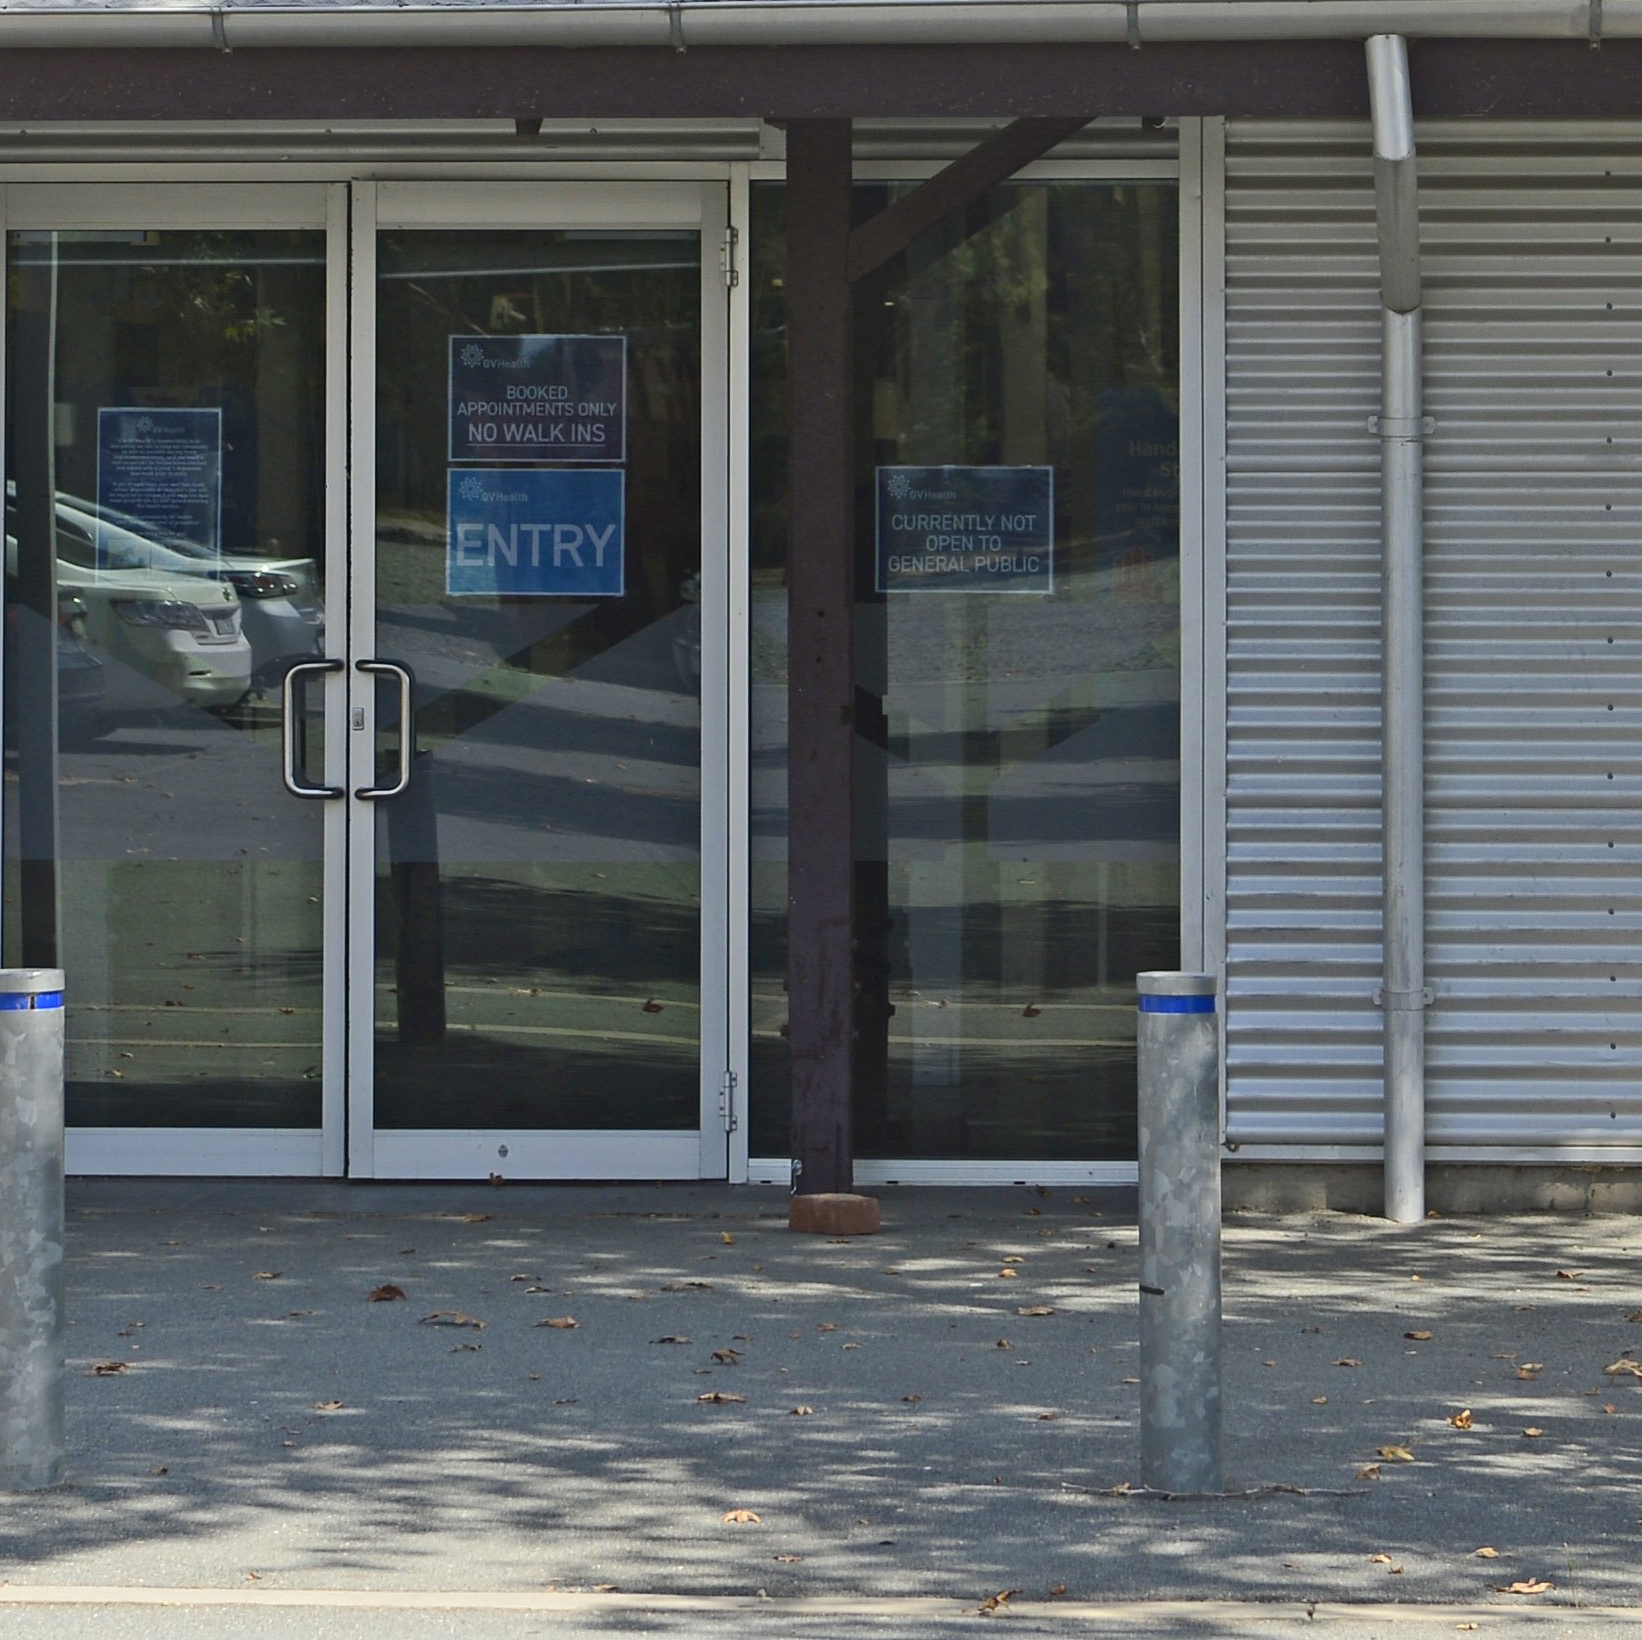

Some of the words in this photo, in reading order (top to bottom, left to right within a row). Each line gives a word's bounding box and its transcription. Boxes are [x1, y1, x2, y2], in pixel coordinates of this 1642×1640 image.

[507, 385, 568, 400] BOOKED
[457, 402, 574, 416] APPOINTMENTS
[578, 402, 617, 416] ONLY
[468, 423, 497, 442] NO
[503, 423, 564, 442] WALK
[571, 423, 606, 442] INS
[891, 514, 997, 531] CURRENTLY
[1001, 514, 1037, 531] NOT
[457, 523, 616, 567] ENTRY
[926, 535, 973, 551] OPEN
[979, 535, 1002, 551] TO
[888, 556, 970, 572] GENERAL
[975, 556, 1040, 572] PUBLIC
